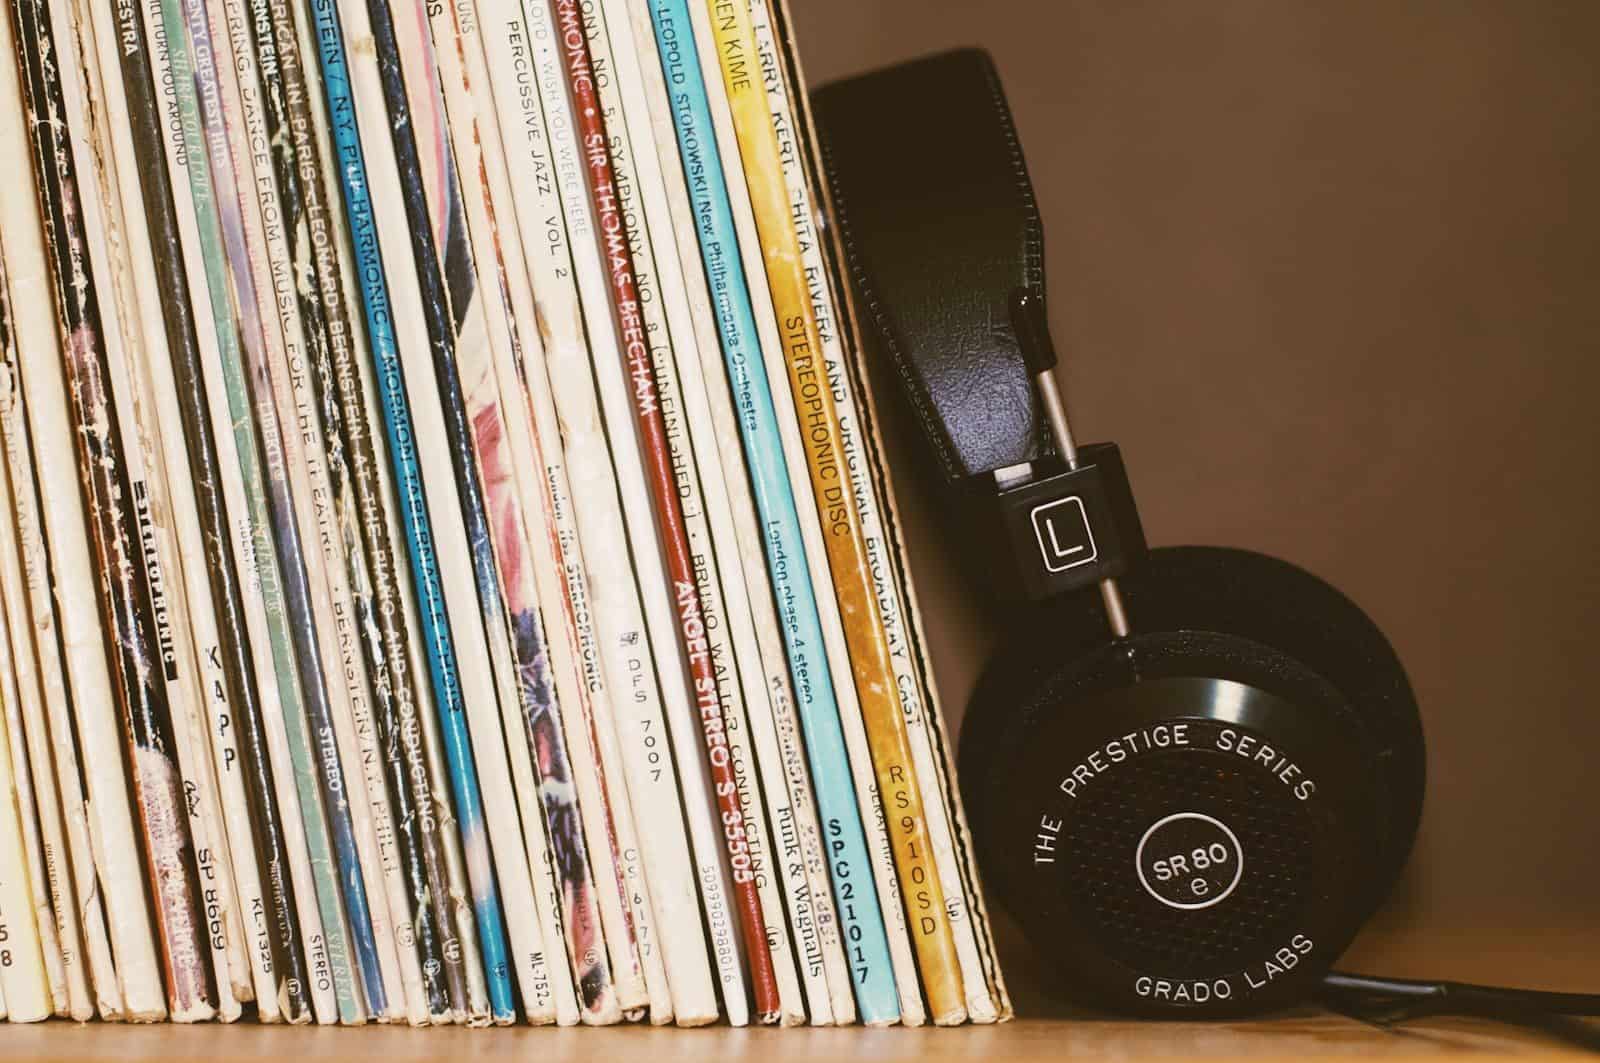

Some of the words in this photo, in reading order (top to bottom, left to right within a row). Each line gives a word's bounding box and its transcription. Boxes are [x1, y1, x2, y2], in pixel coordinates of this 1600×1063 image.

[152, 22, 170, 61] TURN
[711, 0, 738, 31] EN
[159, 65, 176, 96] YOU
[193, 44, 222, 128] GREATEST
[285, 81, 303, 105] IN
[541, 61, 560, 100] WISH
[722, 37, 752, 92] KIME
[166, 100, 188, 166] AROUND
[505, 20, 541, 140] PERCUSSIVE
[530, 148, 551, 195] JAZZ
[544, 215, 563, 255] VOL
[554, 267, 568, 279] 2
[549, 105, 568, 143] YOU
[583, 132, 607, 169] SIR
[557, 146, 578, 191] WERE
[256, 175, 281, 242] FROM
[567, 195, 587, 237] HERE
[592, 180, 631, 287] THOMAS
[656, 7, 686, 85] LEOPOLD
[705, 240, 741, 346] Philharmonia
[729, 352, 760, 432] Orchestra
[314, 0, 341, 66] STEIN
[331, 94, 353, 137] N.Y.
[379, 355, 413, 462] MORMON
[401, 470, 445, 626] TABERNACLE
[433, 635, 462, 713] CHOIR
[327, 319, 364, 440] BERNSTEIN
[616, 298, 657, 416] BEECHAM
[579, 0, 600, 41] ONY
[607, 135, 643, 258] SYMPHONY
[691, 552, 719, 631] BRUNO
[708, 641, 738, 731] WALTER
[729, 744, 769, 889] CONDUCTING
[785, 315, 839, 481] STEREOPHONIC
[823, 485, 852, 537] DISC
[787, 188, 814, 253] HITA
[803, 265, 835, 344] RIVERA
[824, 357, 848, 403] AND
[837, 415, 875, 523] ORIGINAL
[865, 536, 906, 660] BROADWAY
[895, 673, 921, 729] CAST
[352, 453, 371, 480] AT
[359, 491, 381, 539] THE
[1046, 518, 1084, 557] L
[134, 498, 176, 663] STEREOPHONIC
[370, 549, 395, 615] PIANO
[766, 519, 791, 580] London
[793, 652, 816, 704] stereo
[384, 628, 406, 674] AND
[565, 564, 602, 693] STEREOPHONIC
[673, 578, 709, 664] ANGEL
[203, 645, 238, 771] KAPP
[693, 675, 730, 767] STEREO
[317, 725, 342, 792] STEREO
[395, 686, 436, 833] CONDUCTING
[639, 719, 663, 783] 7007
[714, 779, 736, 796] S
[1034, 814, 1063, 864] THE
[1060, 724, 1190, 798] PRESTIGE
[1216, 729, 1316, 801] SERIES
[197, 847, 214, 881] SP
[720, 808, 754, 885] 35505
[776, 805, 801, 857] Funk
[887, 764, 936, 936] RS910SD
[787, 861, 805, 879] &
[825, 818, 872, 985] SPC21017
[1190, 877, 1209, 896] e
[249, 897, 274, 974] KL-1325
[701, 864, 735, 983] 5099902988016
[788, 883, 825, 978] Wagnalls
[308, 934, 330, 992] STEREO
[1135, 976, 1232, 1002] GRADO
[1243, 934, 1313, 989] LABS
